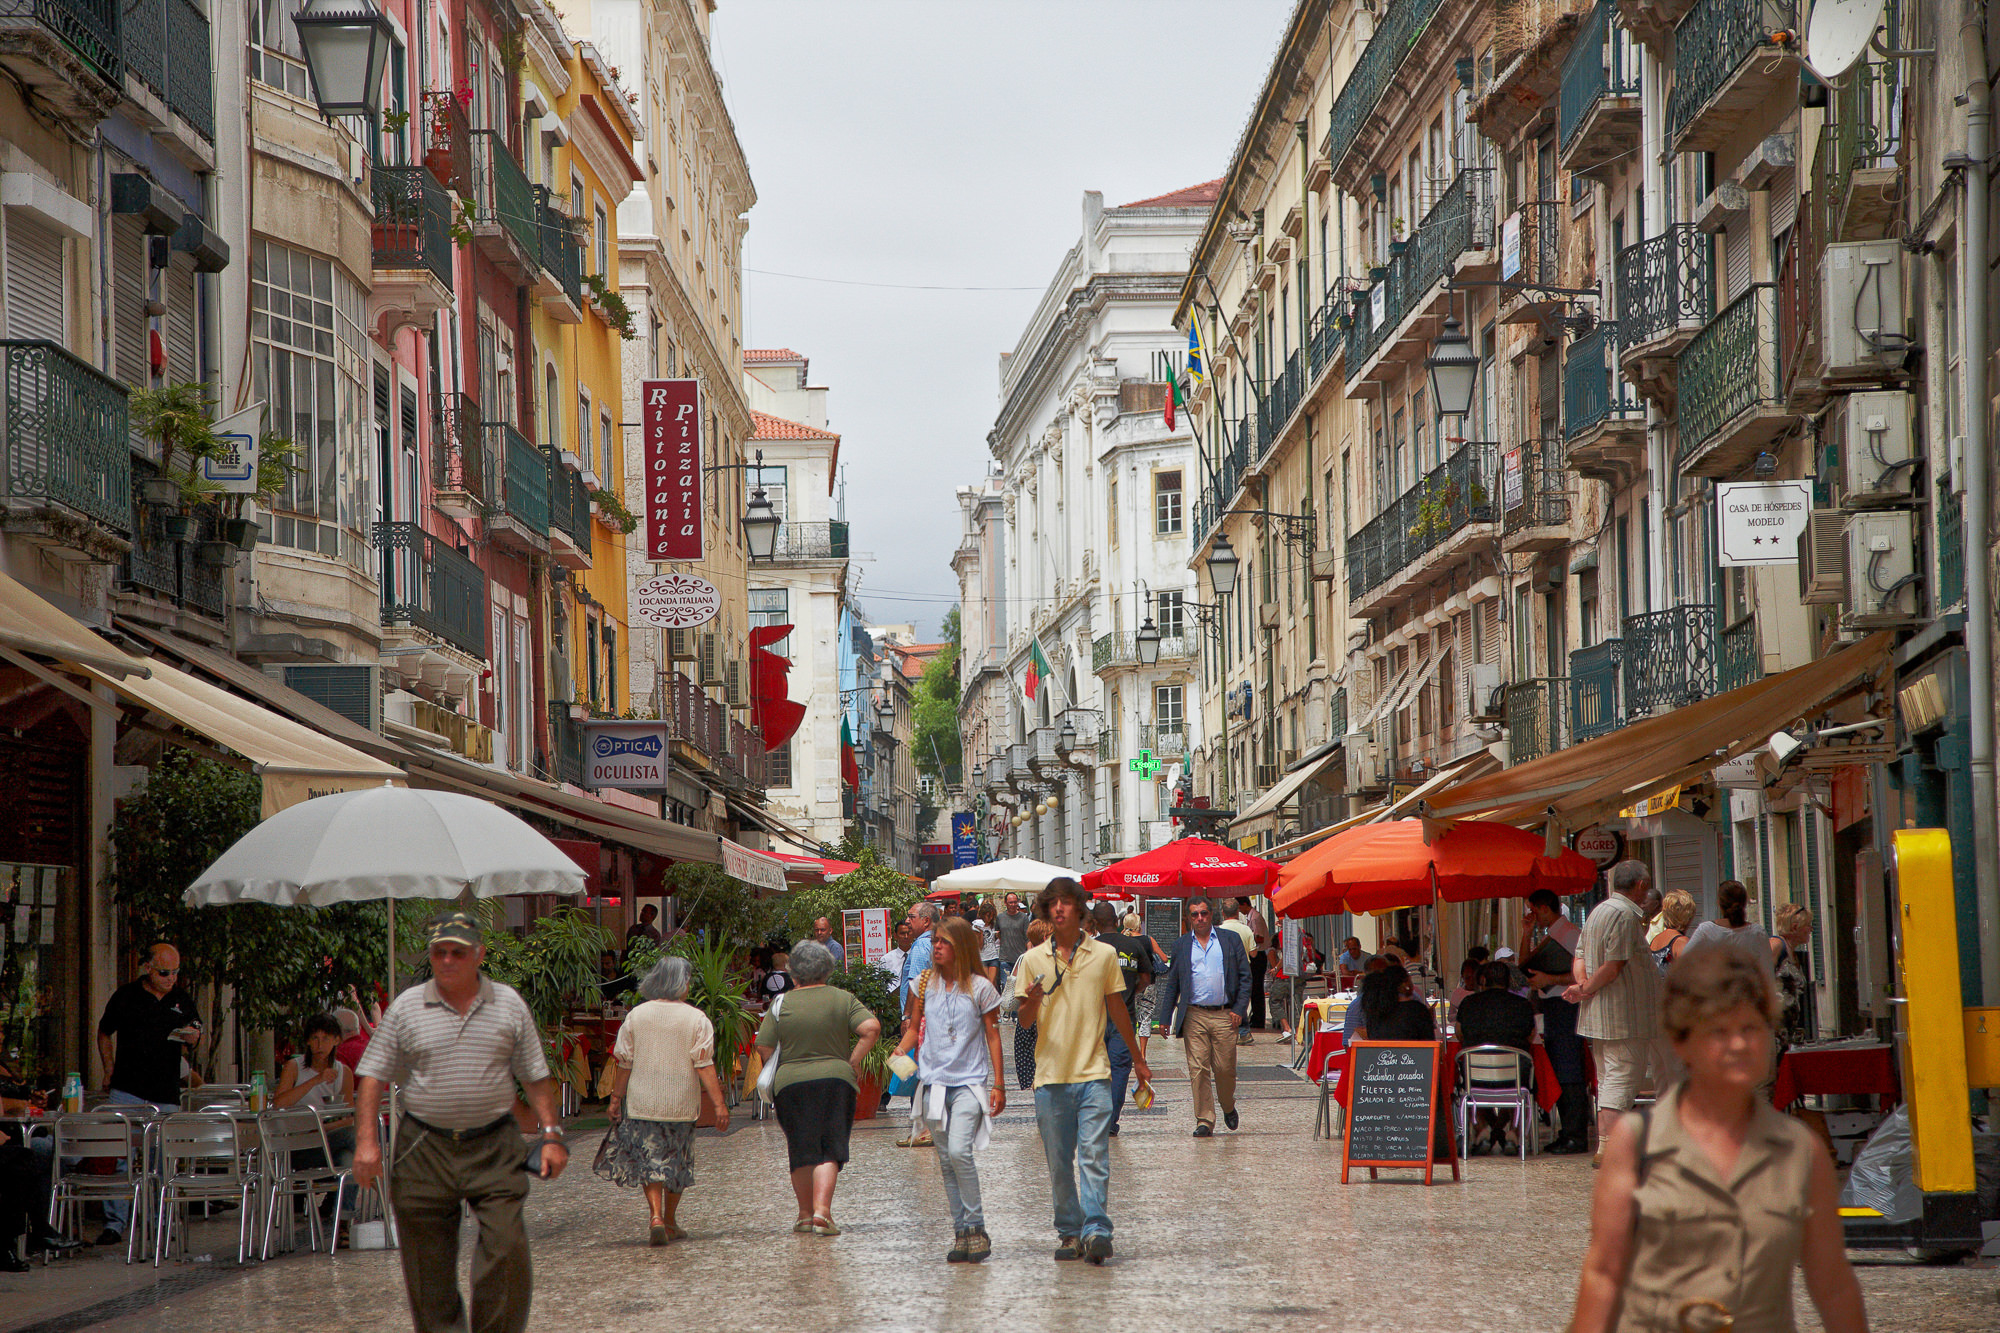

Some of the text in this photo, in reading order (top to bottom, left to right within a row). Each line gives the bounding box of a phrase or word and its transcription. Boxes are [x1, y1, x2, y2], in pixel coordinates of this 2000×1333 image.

[648, 388, 668, 552] Ristorante
[675, 404, 694, 536] Pizzaria
[1729, 501, 1802, 512] CASA DE HÓSPEDES
[1748, 517, 1784, 526] MODELO
[639, 596, 714, 606] LOCANDA ITALIANA
[594, 766, 658, 779] OCULISTA
[1581, 840, 1616, 850] SAGRES
[1132, 874, 1160, 883] SAGRES
[1361, 1085, 1394, 1094] FILETES
